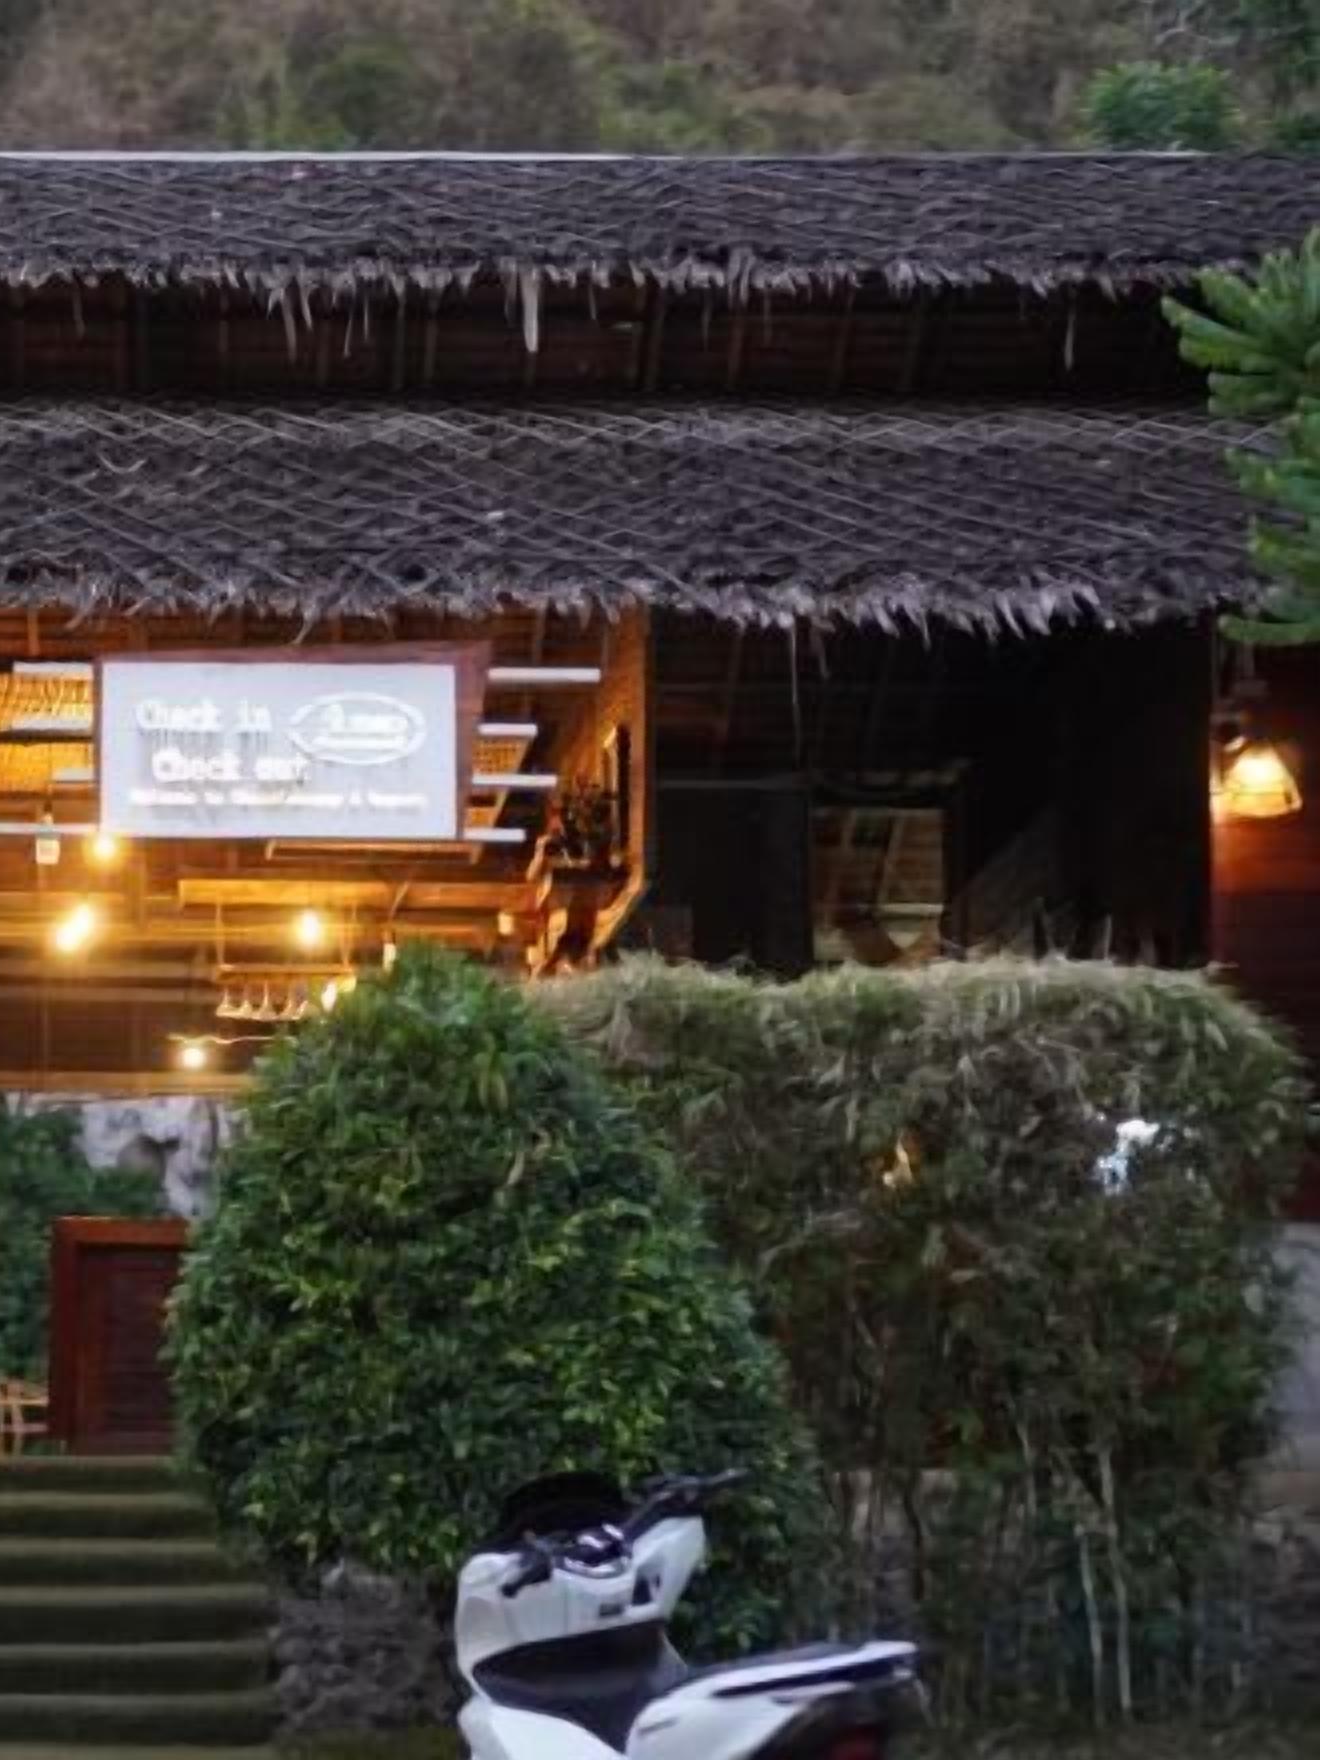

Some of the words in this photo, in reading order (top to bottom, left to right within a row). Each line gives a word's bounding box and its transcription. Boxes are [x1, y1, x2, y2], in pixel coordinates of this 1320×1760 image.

[136, 698, 223, 731] Check
[238, 699, 272, 732] in
[152, 747, 241, 781] Check
